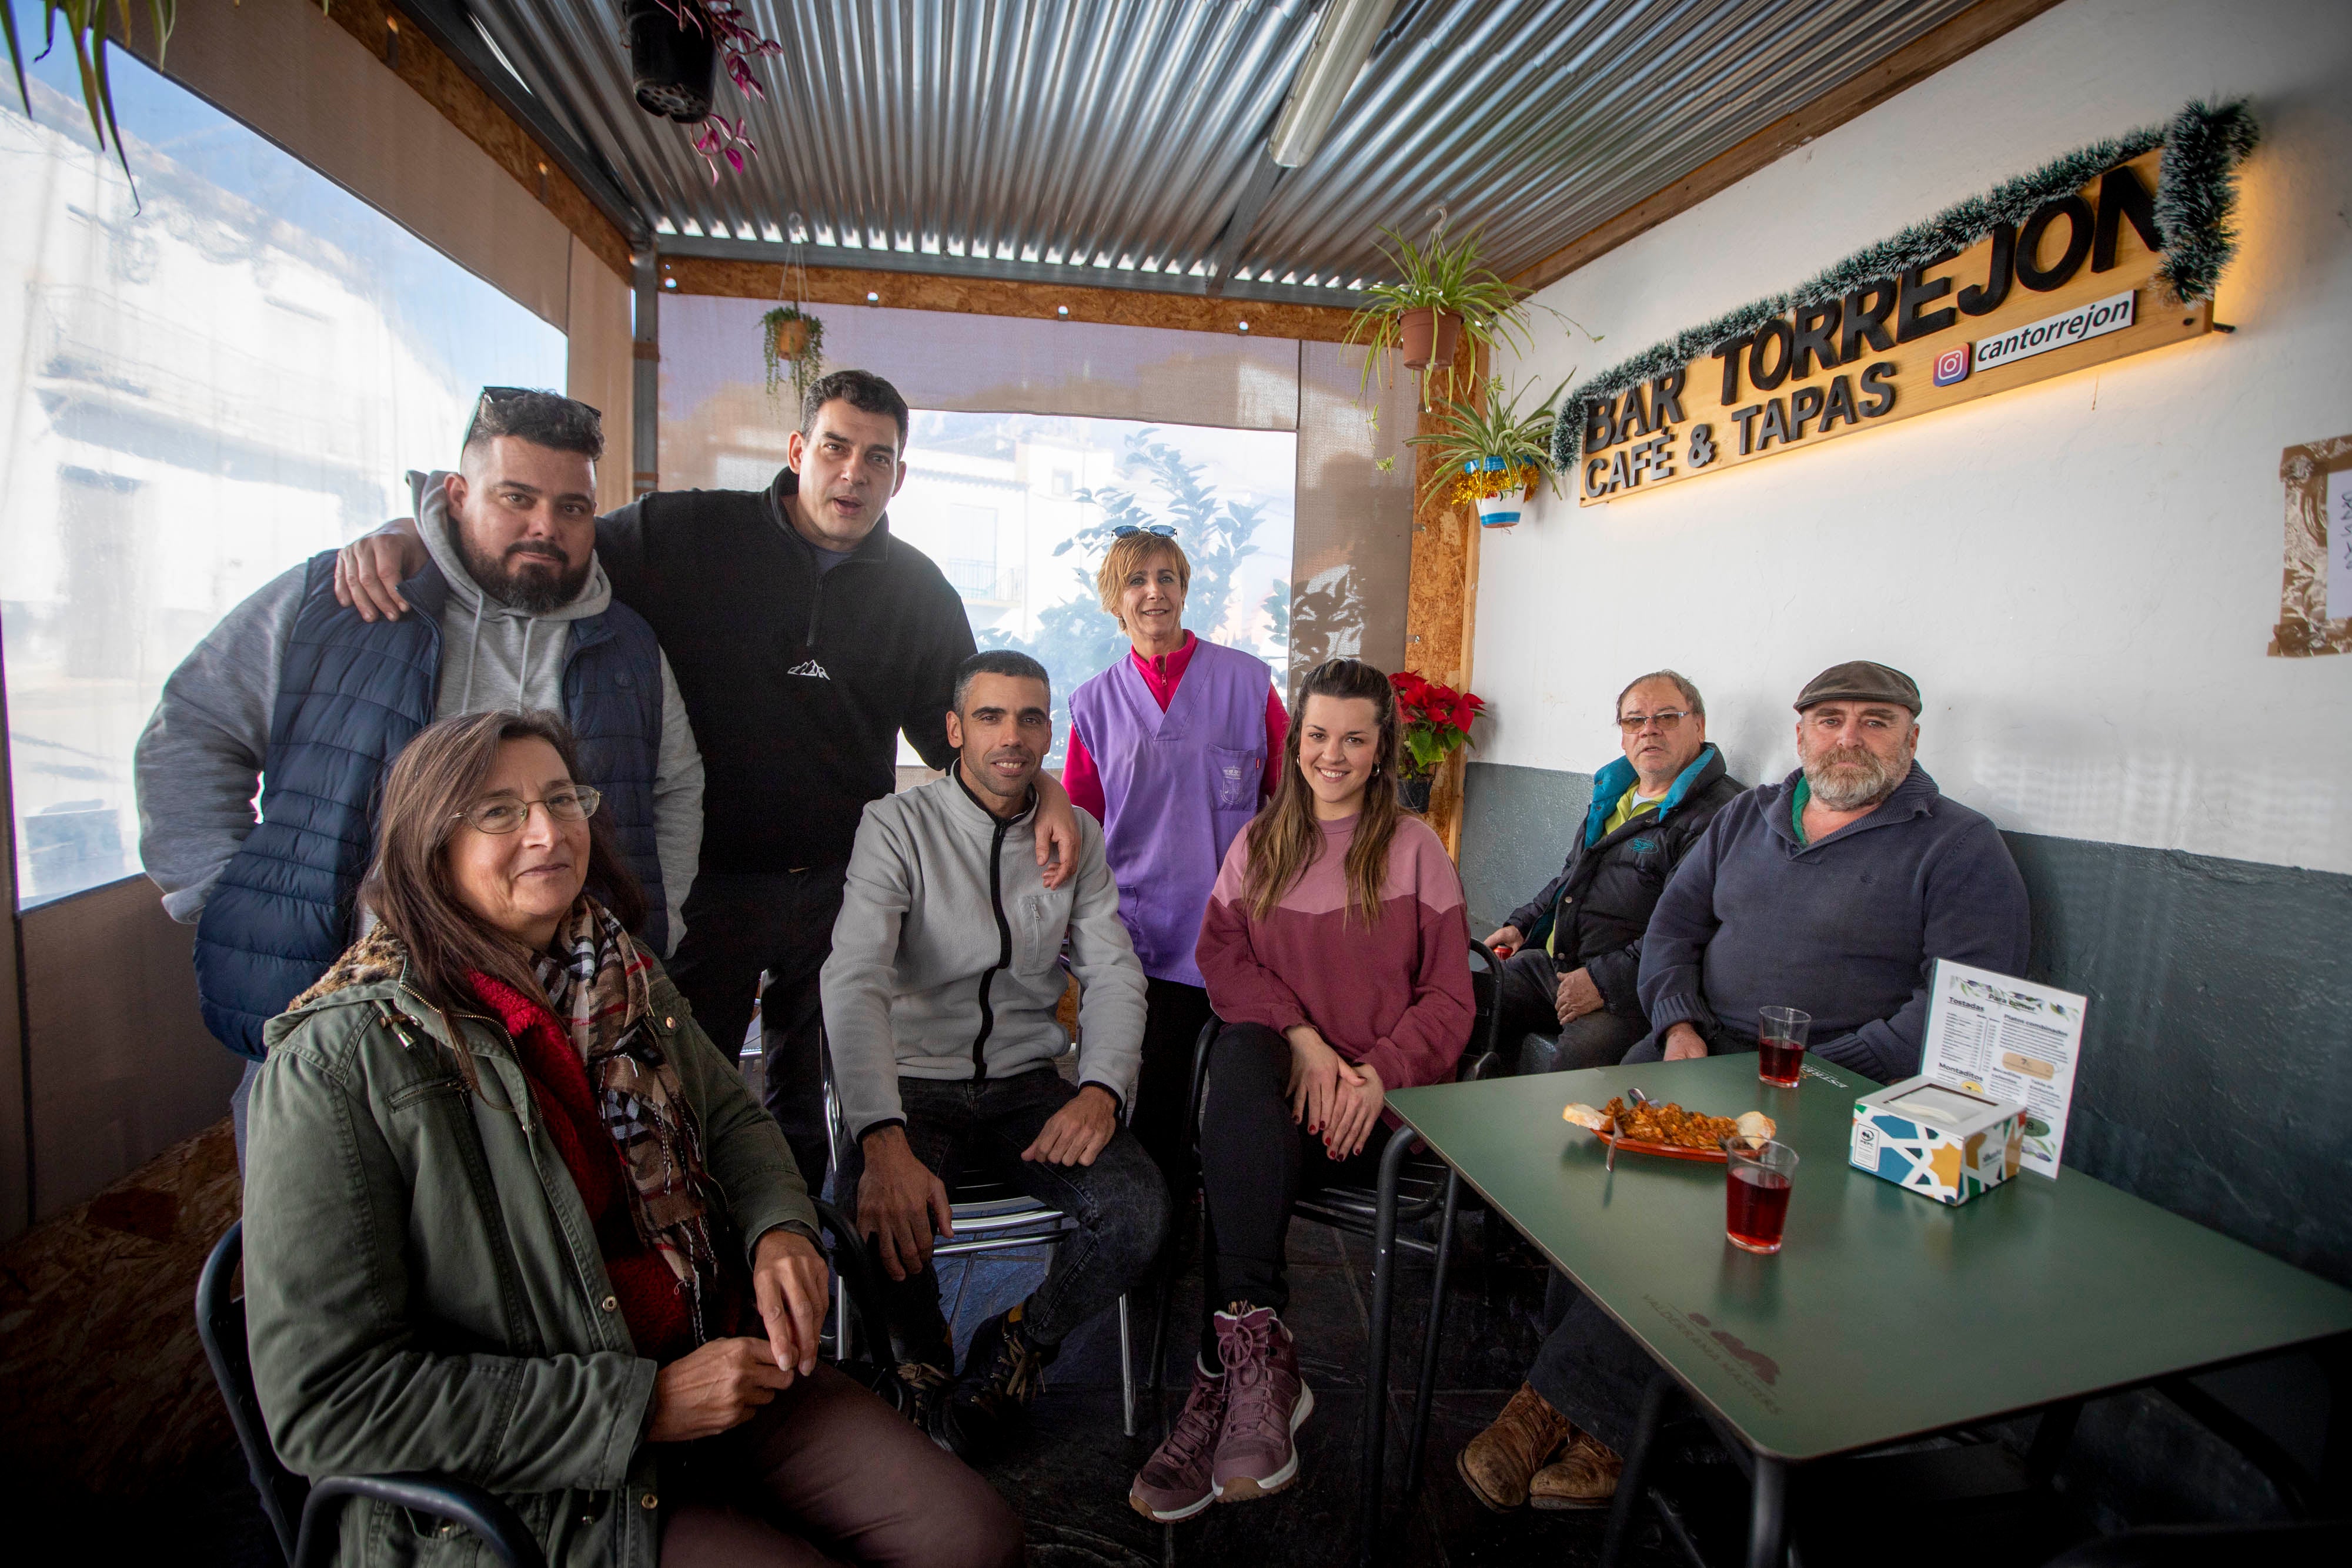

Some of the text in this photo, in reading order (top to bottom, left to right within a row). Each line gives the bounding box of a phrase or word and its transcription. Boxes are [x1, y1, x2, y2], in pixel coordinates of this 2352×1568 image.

[1977, 299, 2129, 362] cantorrejon
[1586, 367, 1686, 454] BAR
[1585, 362, 1897, 498] CAFÉ & TAPAS
[1949, 997, 1985, 1011] Tostadas
[1988, 994, 2036, 1011] Para comer
[2004, 1014, 2024, 1024] Platos
[2026, 1021, 2069, 1037] combinados
[1939, 1062, 1983, 1081] Montaditos
